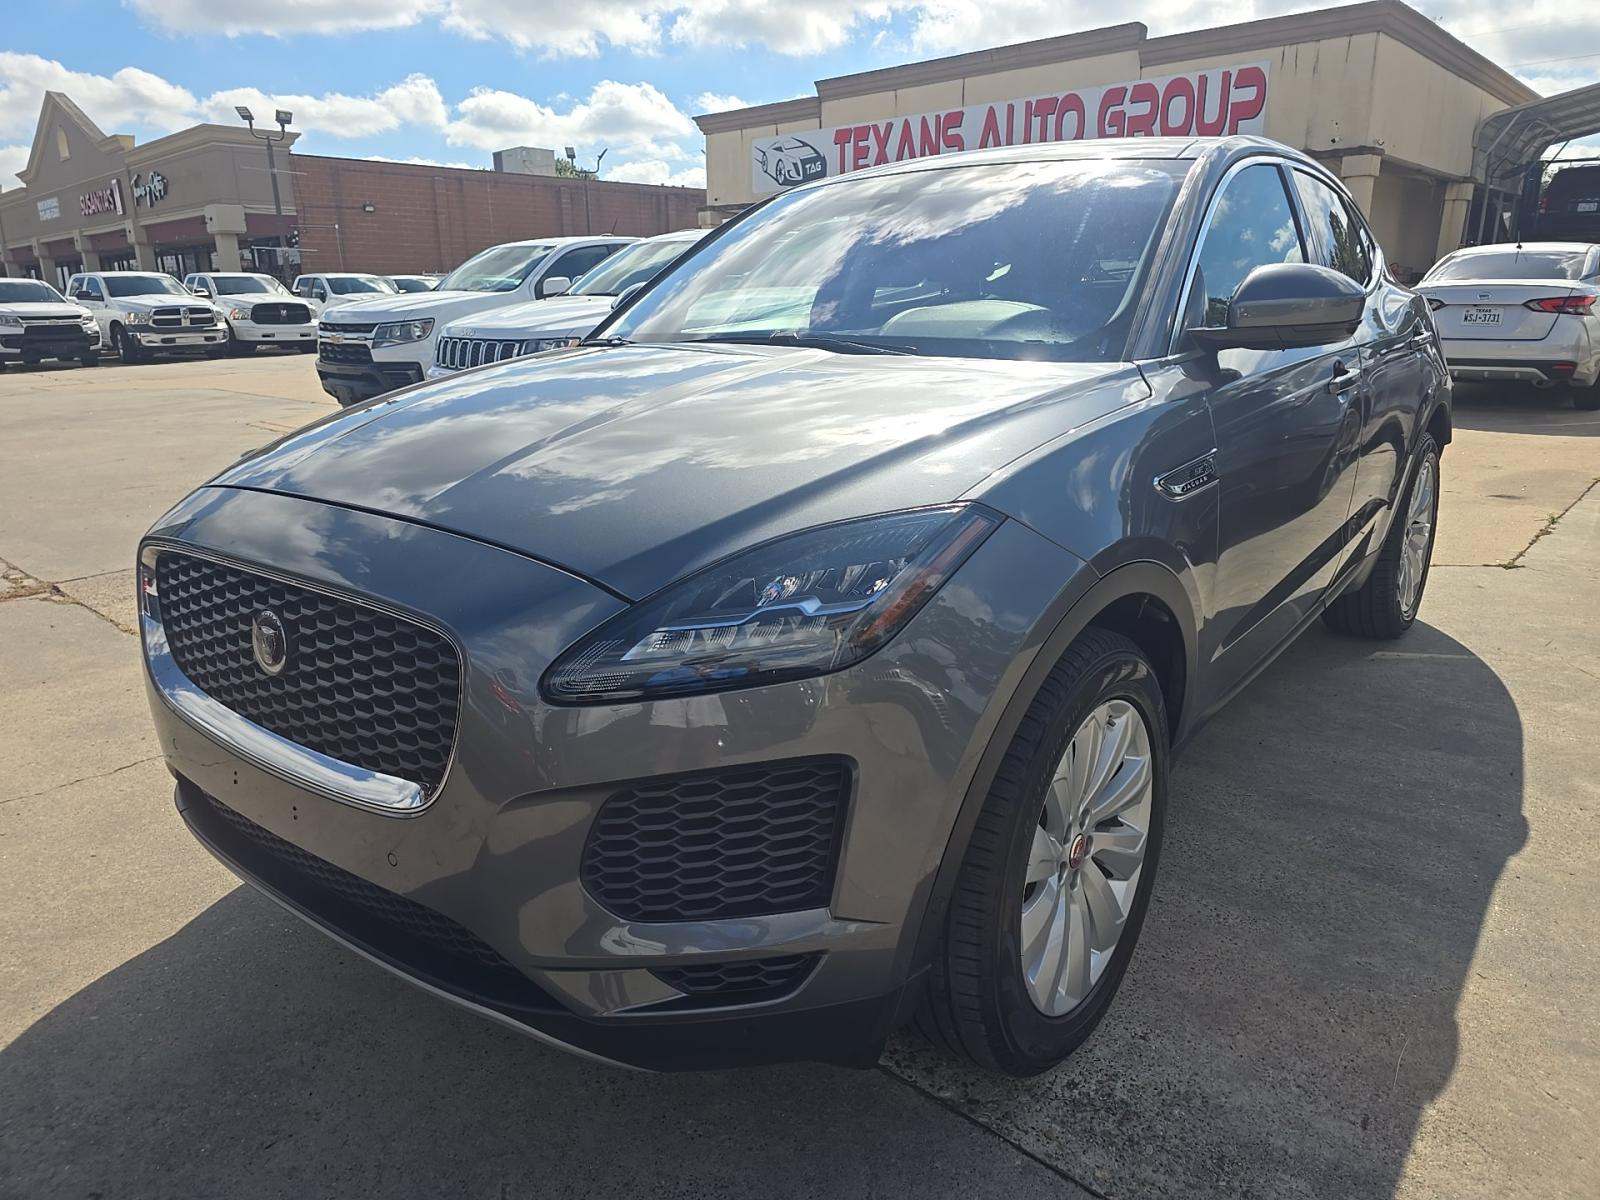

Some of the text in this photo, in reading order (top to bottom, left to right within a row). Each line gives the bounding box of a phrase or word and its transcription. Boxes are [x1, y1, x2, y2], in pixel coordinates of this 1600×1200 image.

[833, 66, 1267, 174] TEXANS AUTO GROUP
[805, 161, 822, 174] TAG
[1183, 476, 1208, 492] JAGUAR
